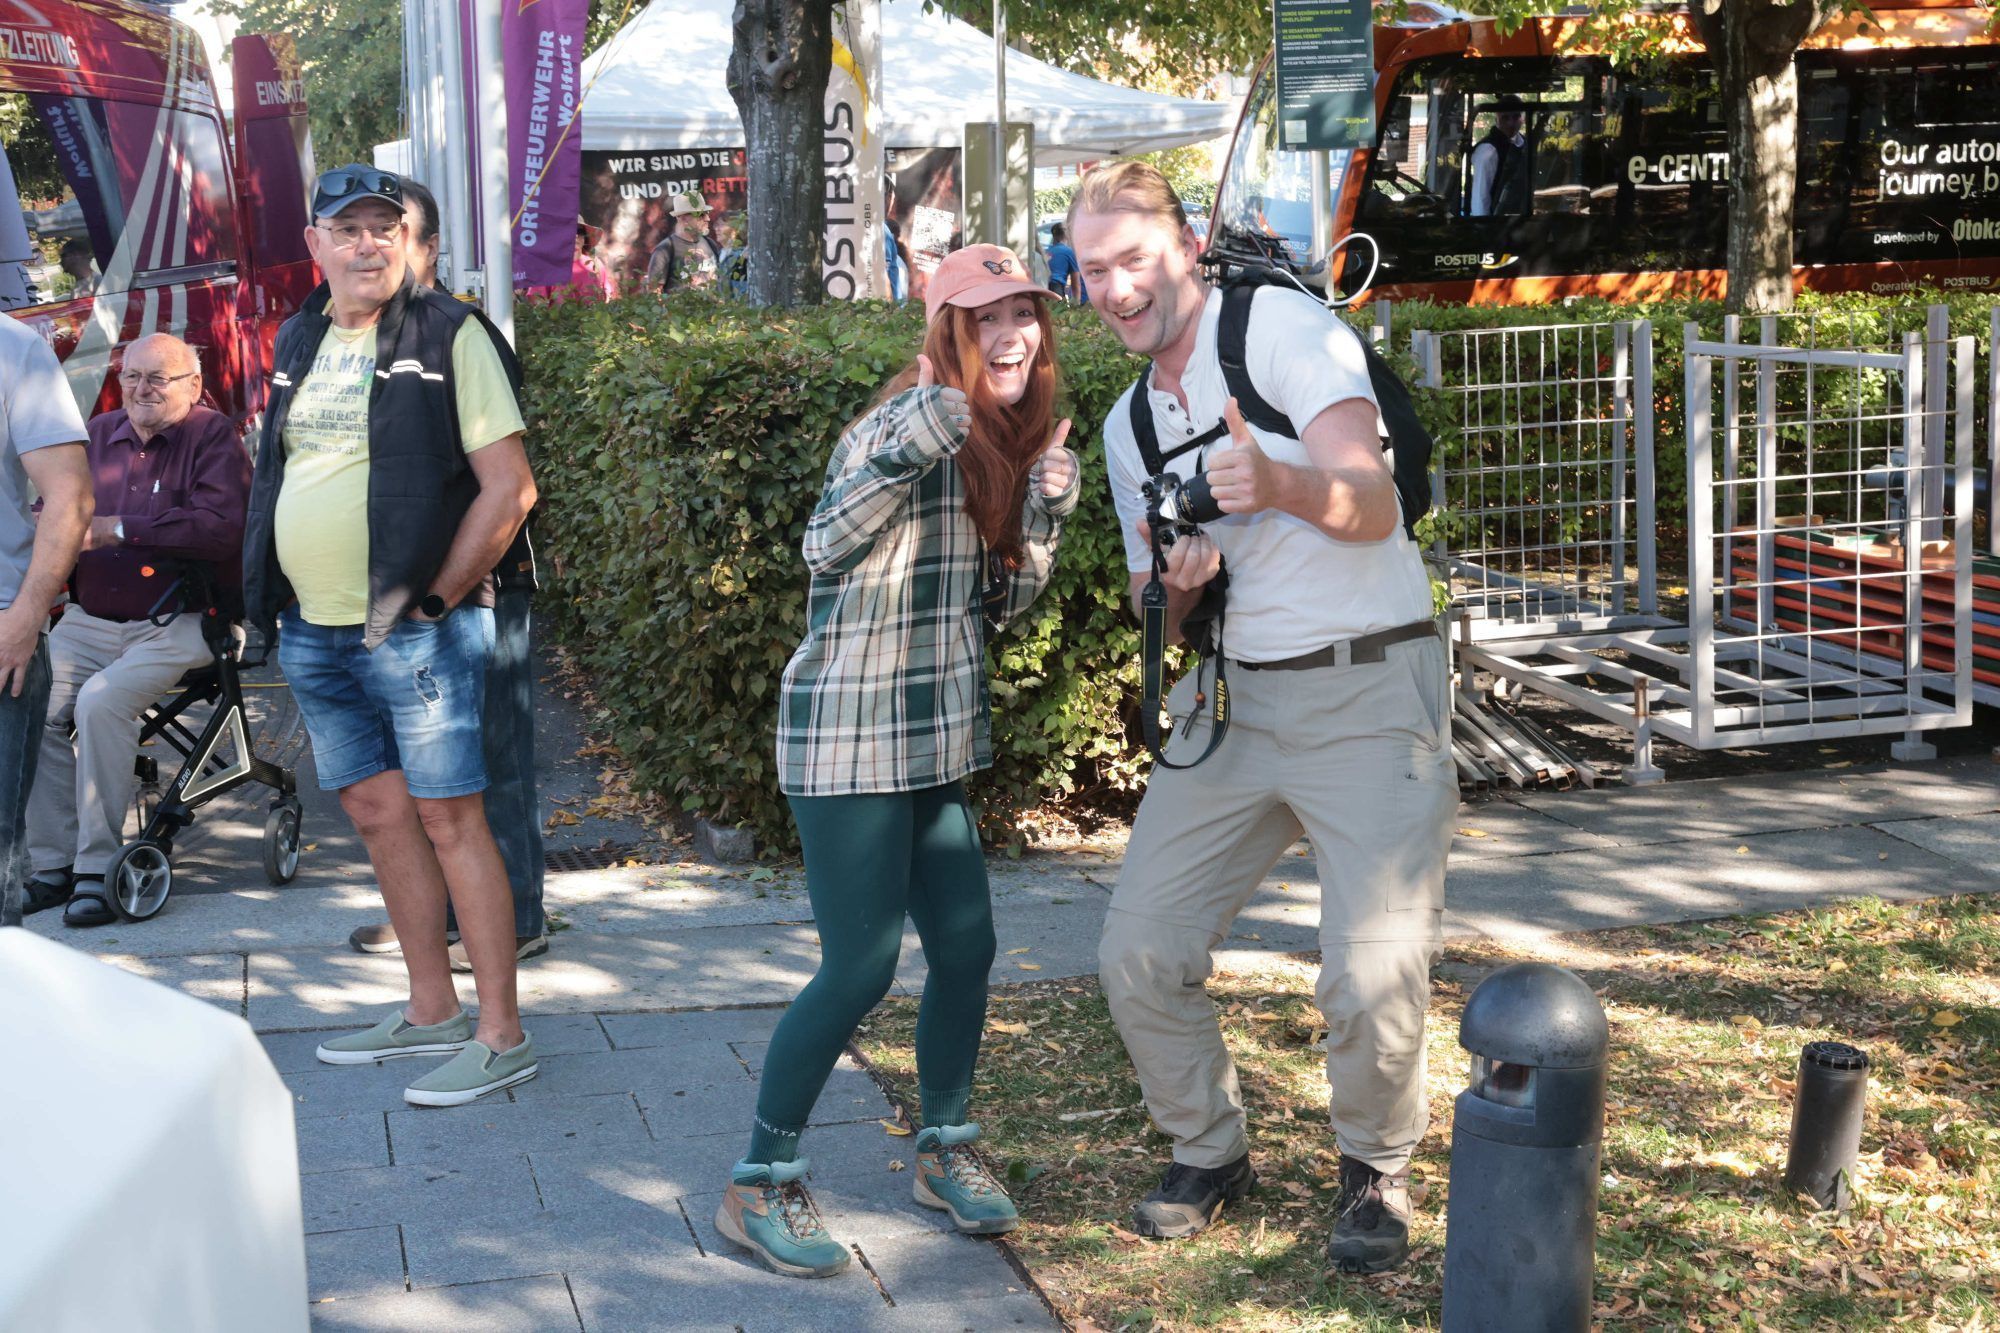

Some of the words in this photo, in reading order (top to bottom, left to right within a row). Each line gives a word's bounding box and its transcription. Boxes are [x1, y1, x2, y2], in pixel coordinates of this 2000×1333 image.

[557, 34, 574, 127] Wolfurt
[520, 30, 555, 247] ORTSFEUERWEHR
[608, 157, 646, 174] WIR
[651, 154, 696, 171] SIND
[701, 151, 729, 167] DIE
[1880, 139, 1929, 166] Our
[1935, 138, 2000, 165] auto
[620, 181, 662, 200] UND
[667, 179, 700, 197] DIE
[703, 177, 747, 194] RETT
[1876, 168, 1975, 202] journey
[823, 102, 856, 301] OSTBUS
[1873, 231, 1925, 244] Developed
[1927, 231, 1940, 244] by
[1434, 253, 1495, 266] POSTBUS
[1871, 279, 1917, 293] Operated
[1943, 276, 1990, 287] POSTBUS
[1216, 678, 1226, 721] Nikon
